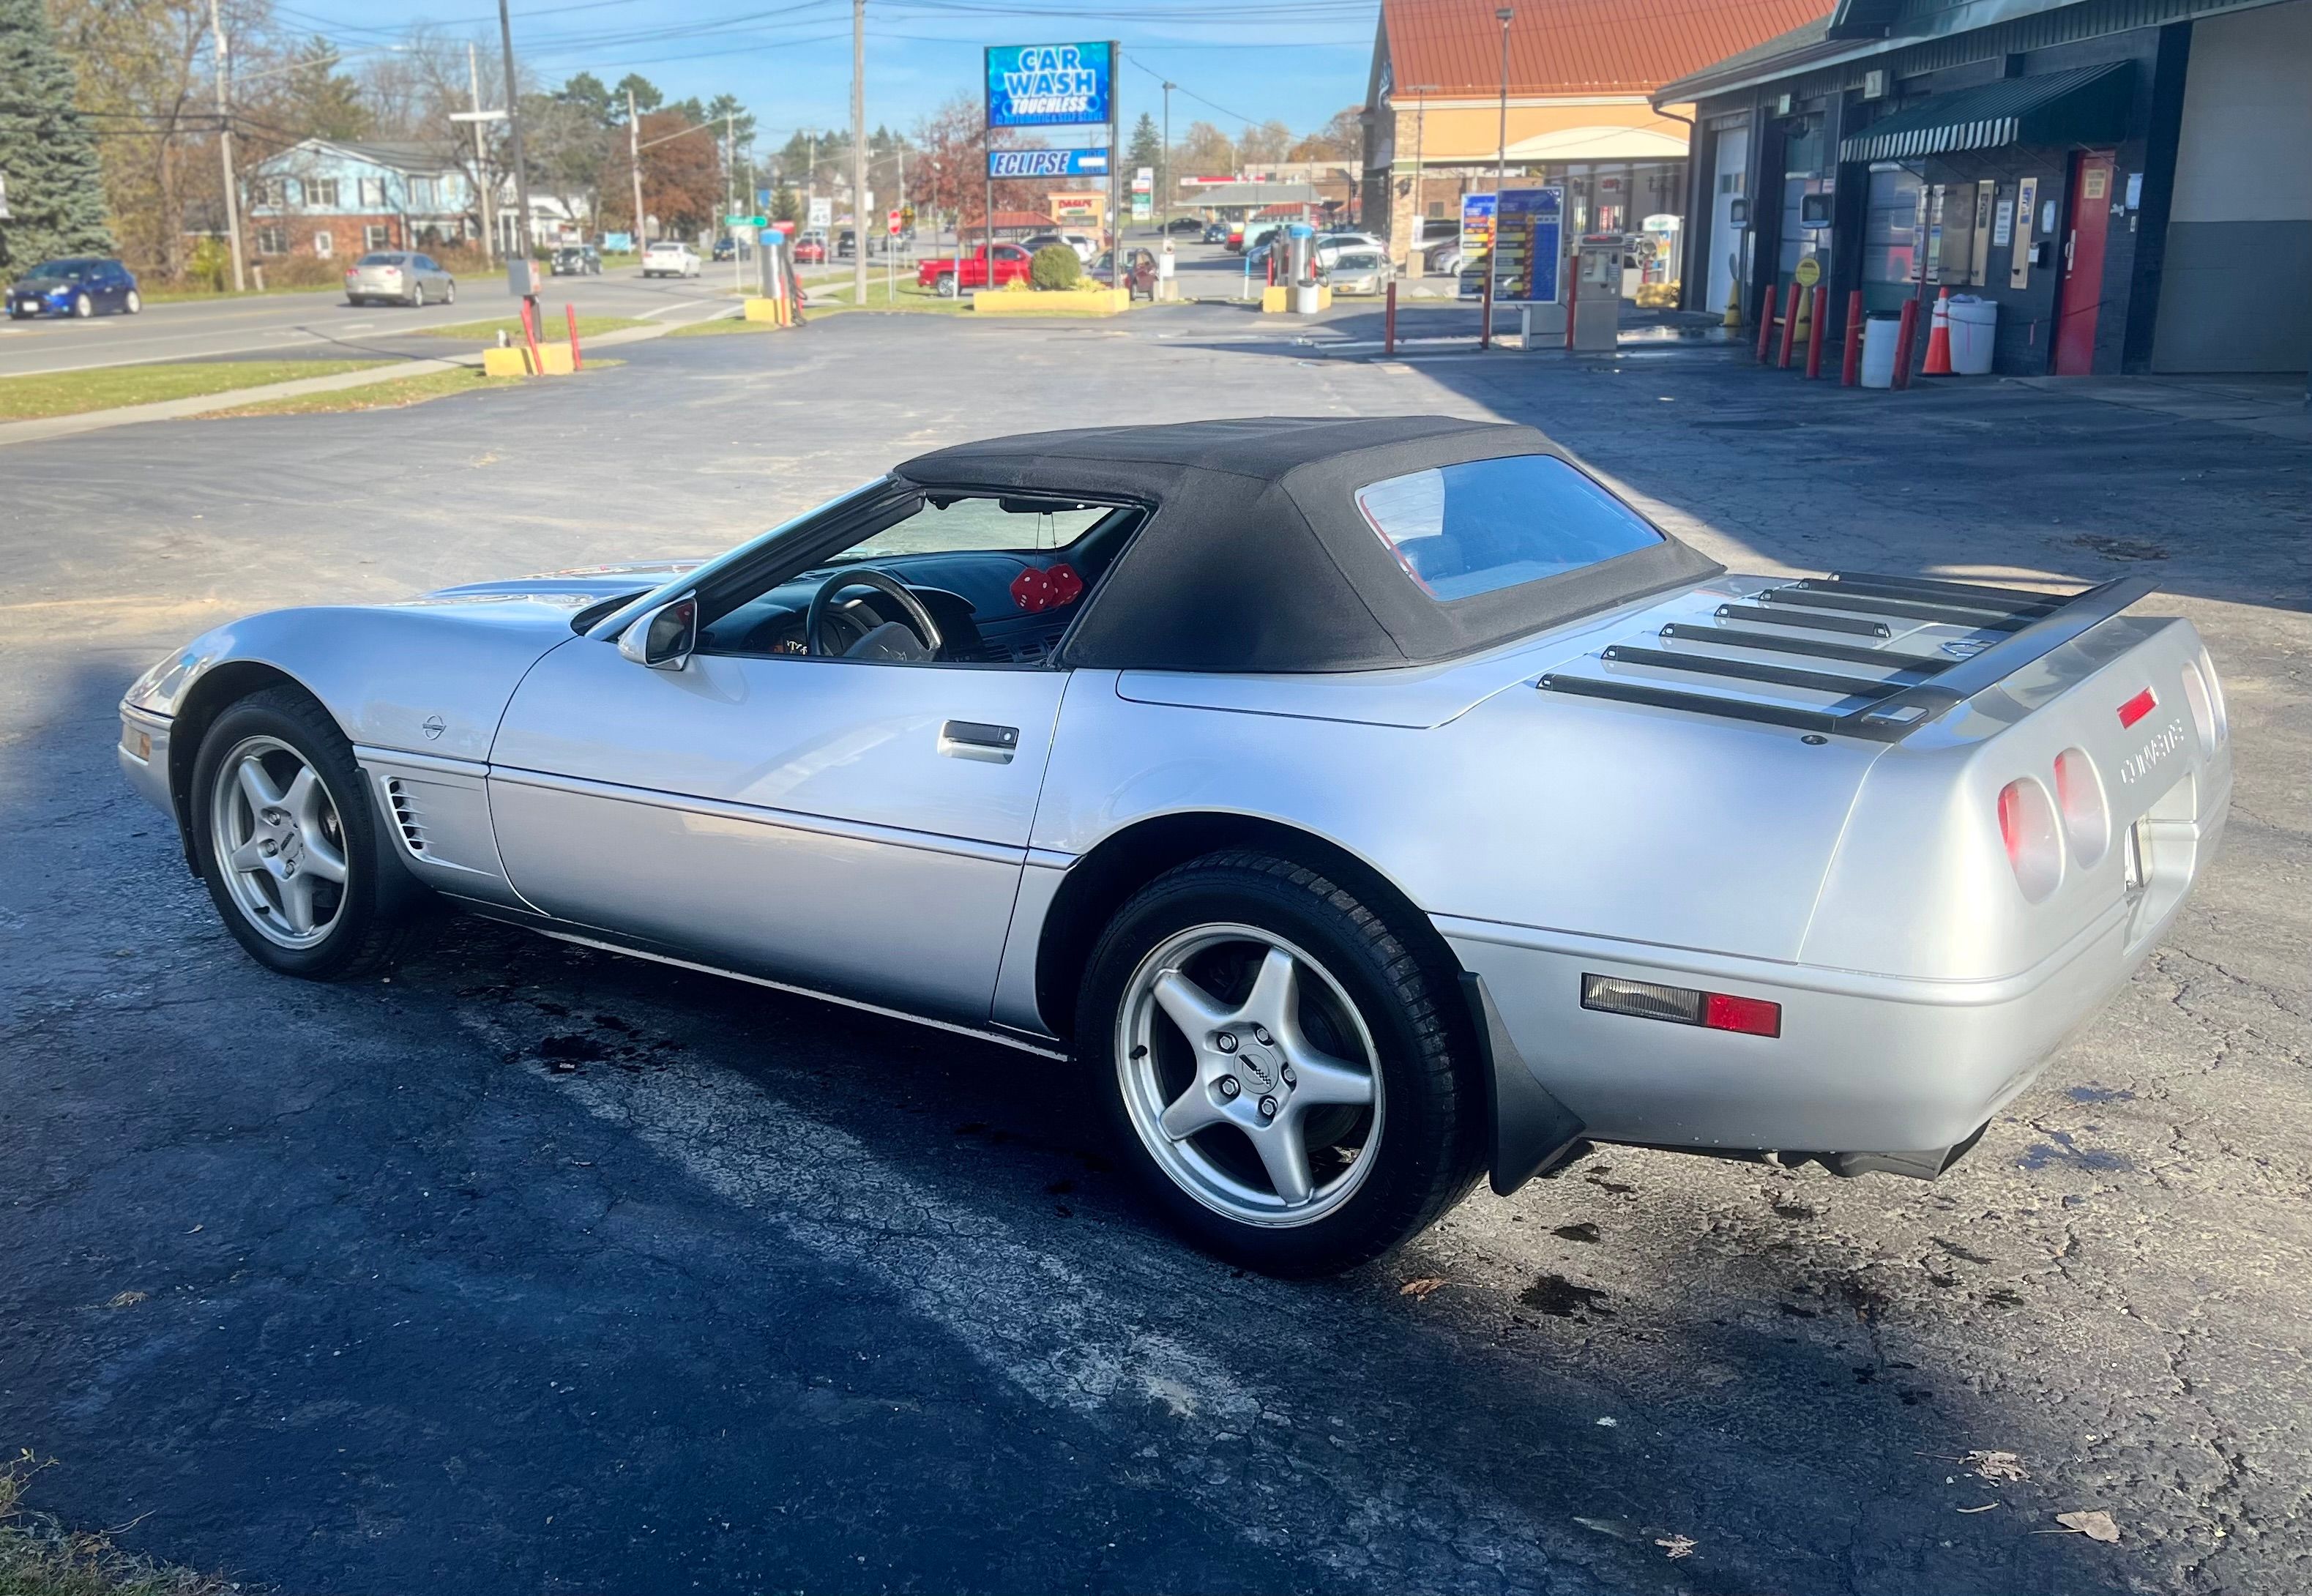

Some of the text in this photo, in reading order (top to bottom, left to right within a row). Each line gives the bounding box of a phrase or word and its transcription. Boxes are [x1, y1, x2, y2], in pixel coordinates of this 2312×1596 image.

[1019, 46, 1082, 72] CAR
[1004, 70, 1096, 98] WASH
[1011, 97, 1088, 114] TOUCHLESS
[1004, 113, 1050, 124] AUTOMATIC
[1058, 113, 1076, 122] SELF
[1077, 111, 1103, 121] SERVE
[993, 152, 1070, 175] ECLIPSE
[813, 214, 829, 223] 45
